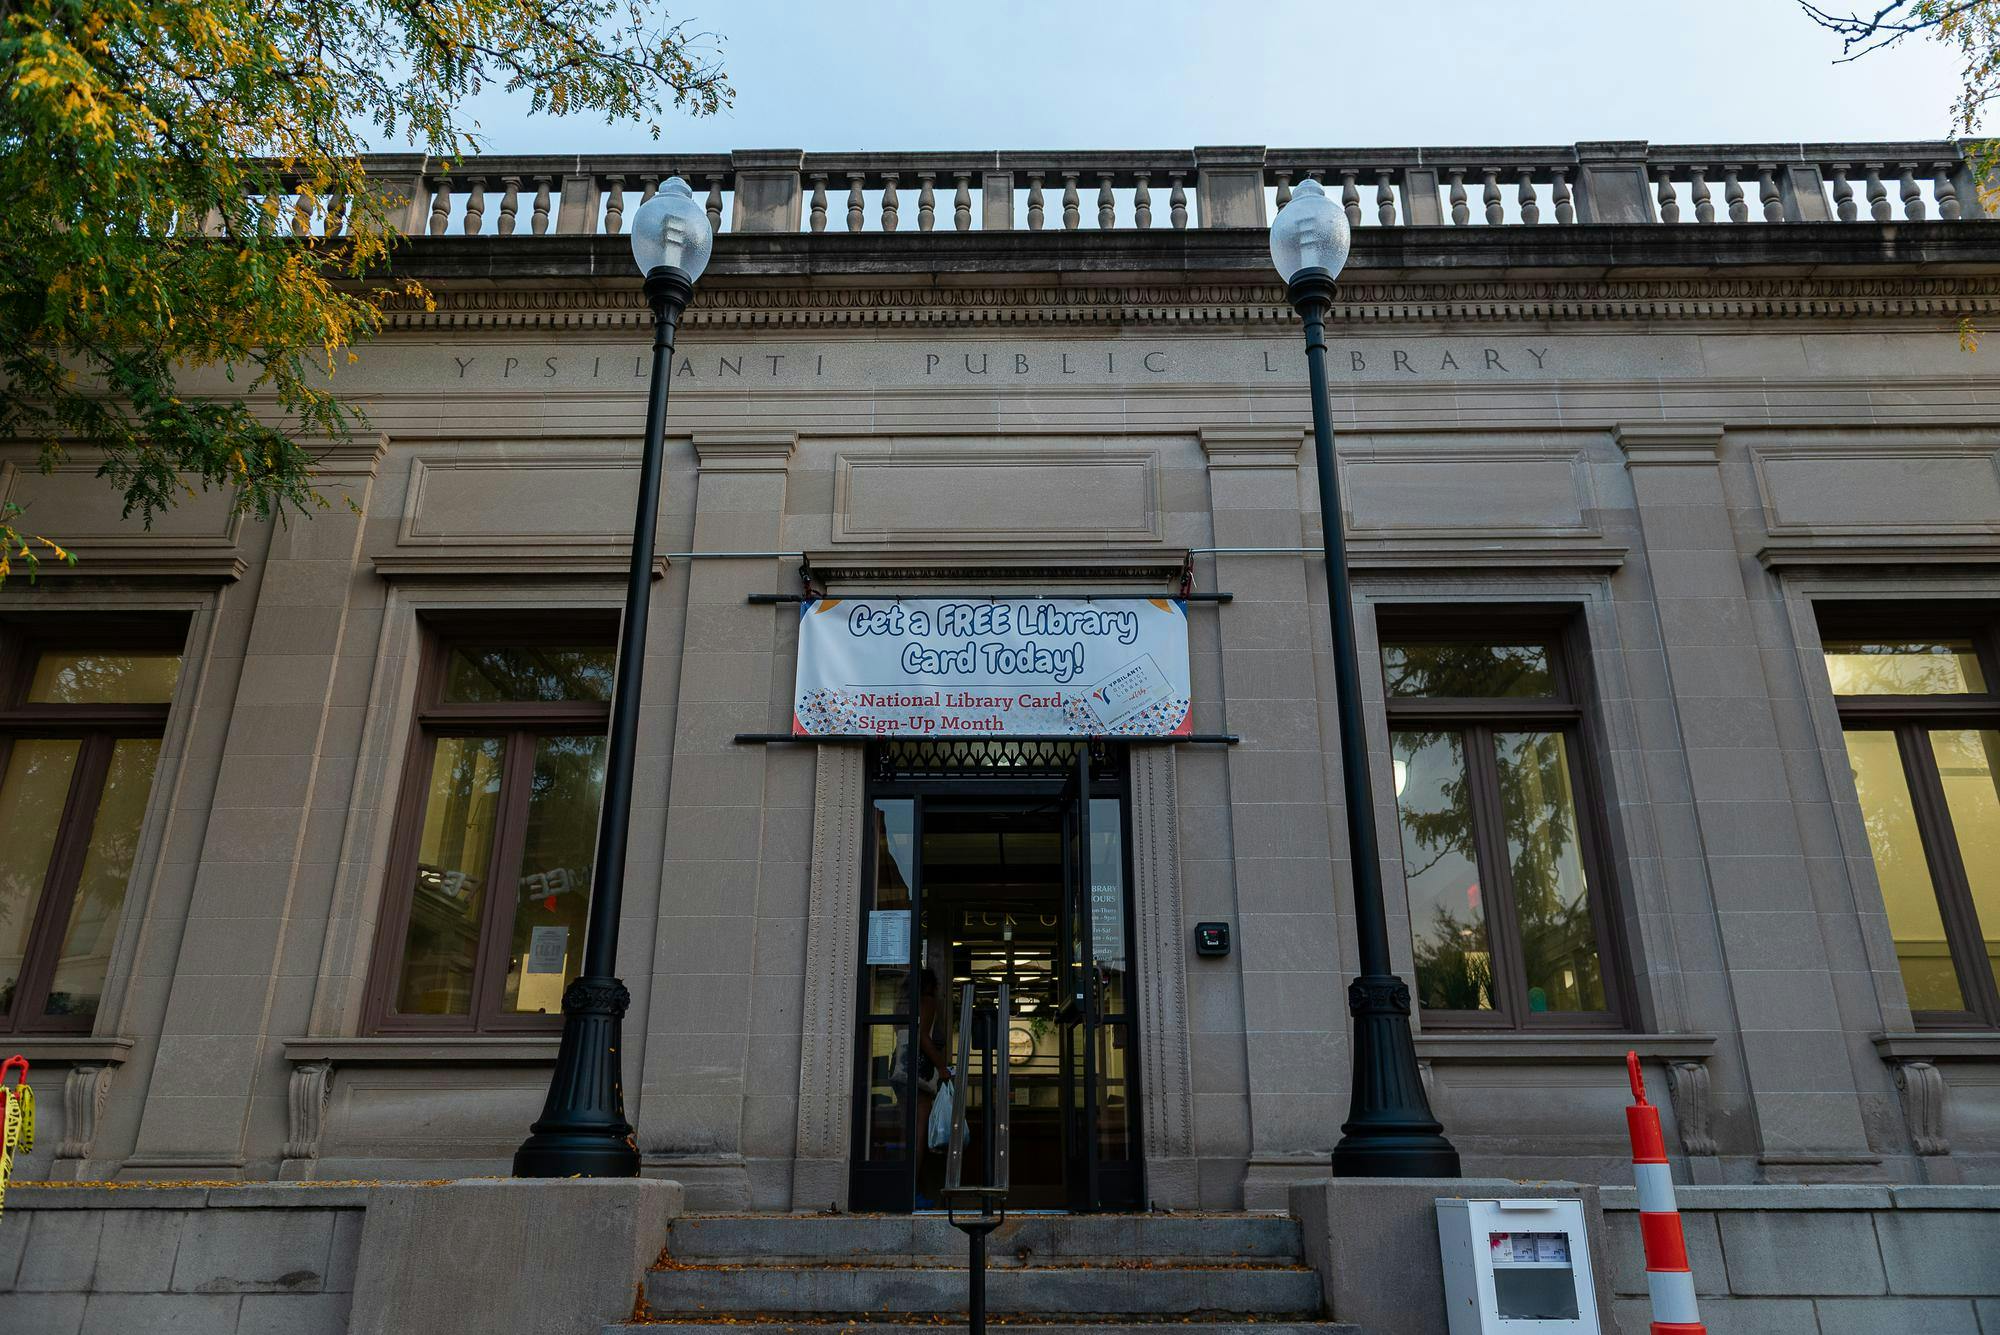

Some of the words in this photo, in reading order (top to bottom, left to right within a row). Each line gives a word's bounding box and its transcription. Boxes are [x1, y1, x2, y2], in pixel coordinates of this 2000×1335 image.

[454, 354, 823, 378] YPSILANTI
[926, 352, 1166, 375] PUBLIC
[1263, 348, 1549, 374] LBRARY
[848, 604, 905, 637] Get
[908, 611, 931, 637] a
[937, 604, 1011, 637] FREE
[1017, 604, 1139, 645] Library
[901, 642, 976, 675] Card
[980, 641, 1084, 684] Today!
[859, 692, 941, 708] National
[945, 693, 1014, 712] Library
[1018, 692, 1063, 709] Card
[858, 715, 936, 734] Sign-Up
[940, 715, 1005, 731] Month
[1091, 885, 1118, 893] BRARY
[1092, 895, 1116, 903] OURS
